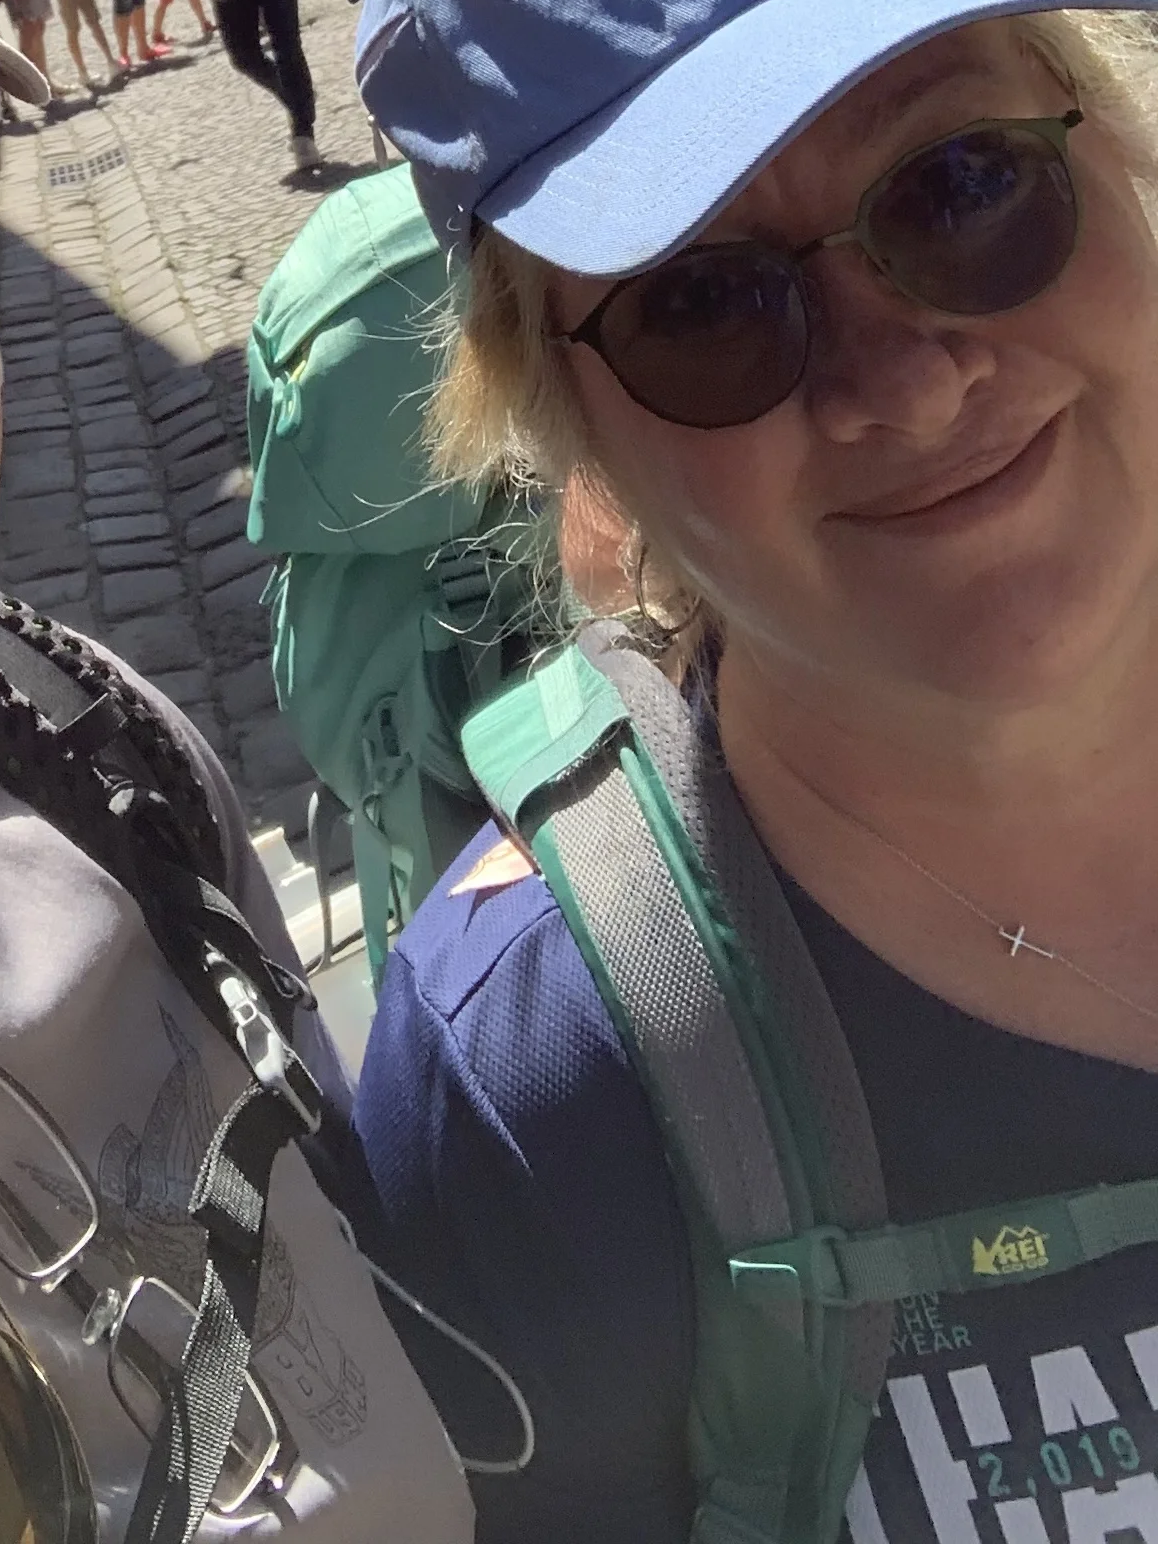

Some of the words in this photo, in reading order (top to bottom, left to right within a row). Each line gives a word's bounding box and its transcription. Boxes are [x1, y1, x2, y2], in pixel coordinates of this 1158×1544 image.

[997, 1234, 1047, 1265] REI
[894, 1306, 944, 1335] HE
[891, 1325, 972, 1356] YEAR
[978, 1426, 1140, 1497] 2,019
